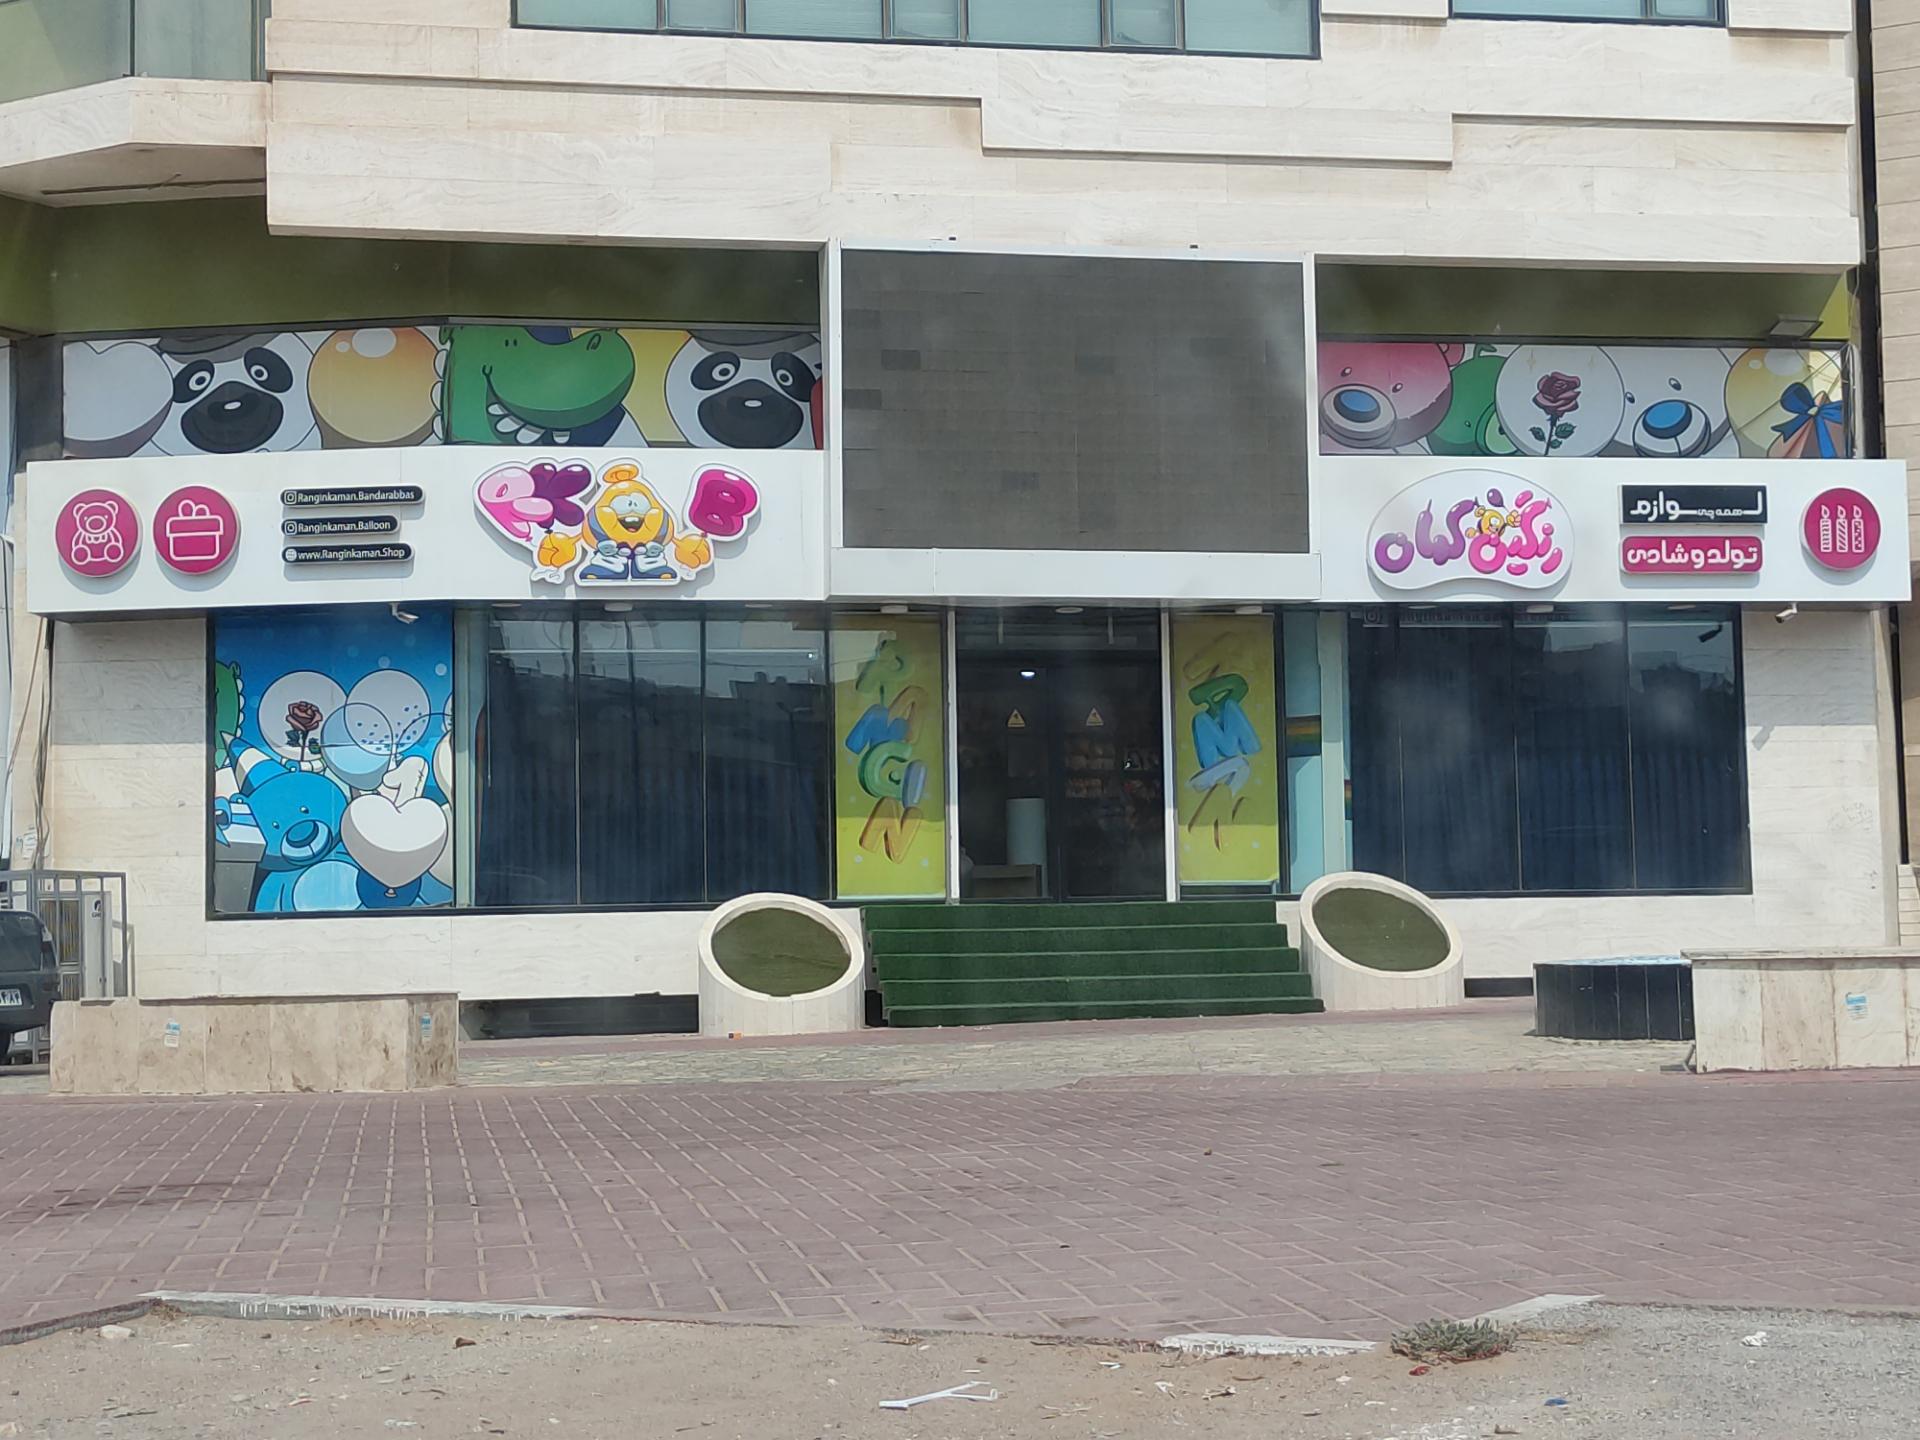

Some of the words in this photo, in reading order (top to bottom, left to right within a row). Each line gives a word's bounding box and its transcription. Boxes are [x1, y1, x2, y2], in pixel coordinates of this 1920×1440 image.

[298, 489, 415, 504] Ranginkaman.Bandarabbas
[298, 520, 391, 534] Ranginkaman.Balloon
[1374, 496, 1480, 575] کمان
[1468, 490, 1563, 576] رنگین
[298, 547, 405, 561] www.Ranginkaman.Shop
[1707, 539, 1758, 568] تولد
